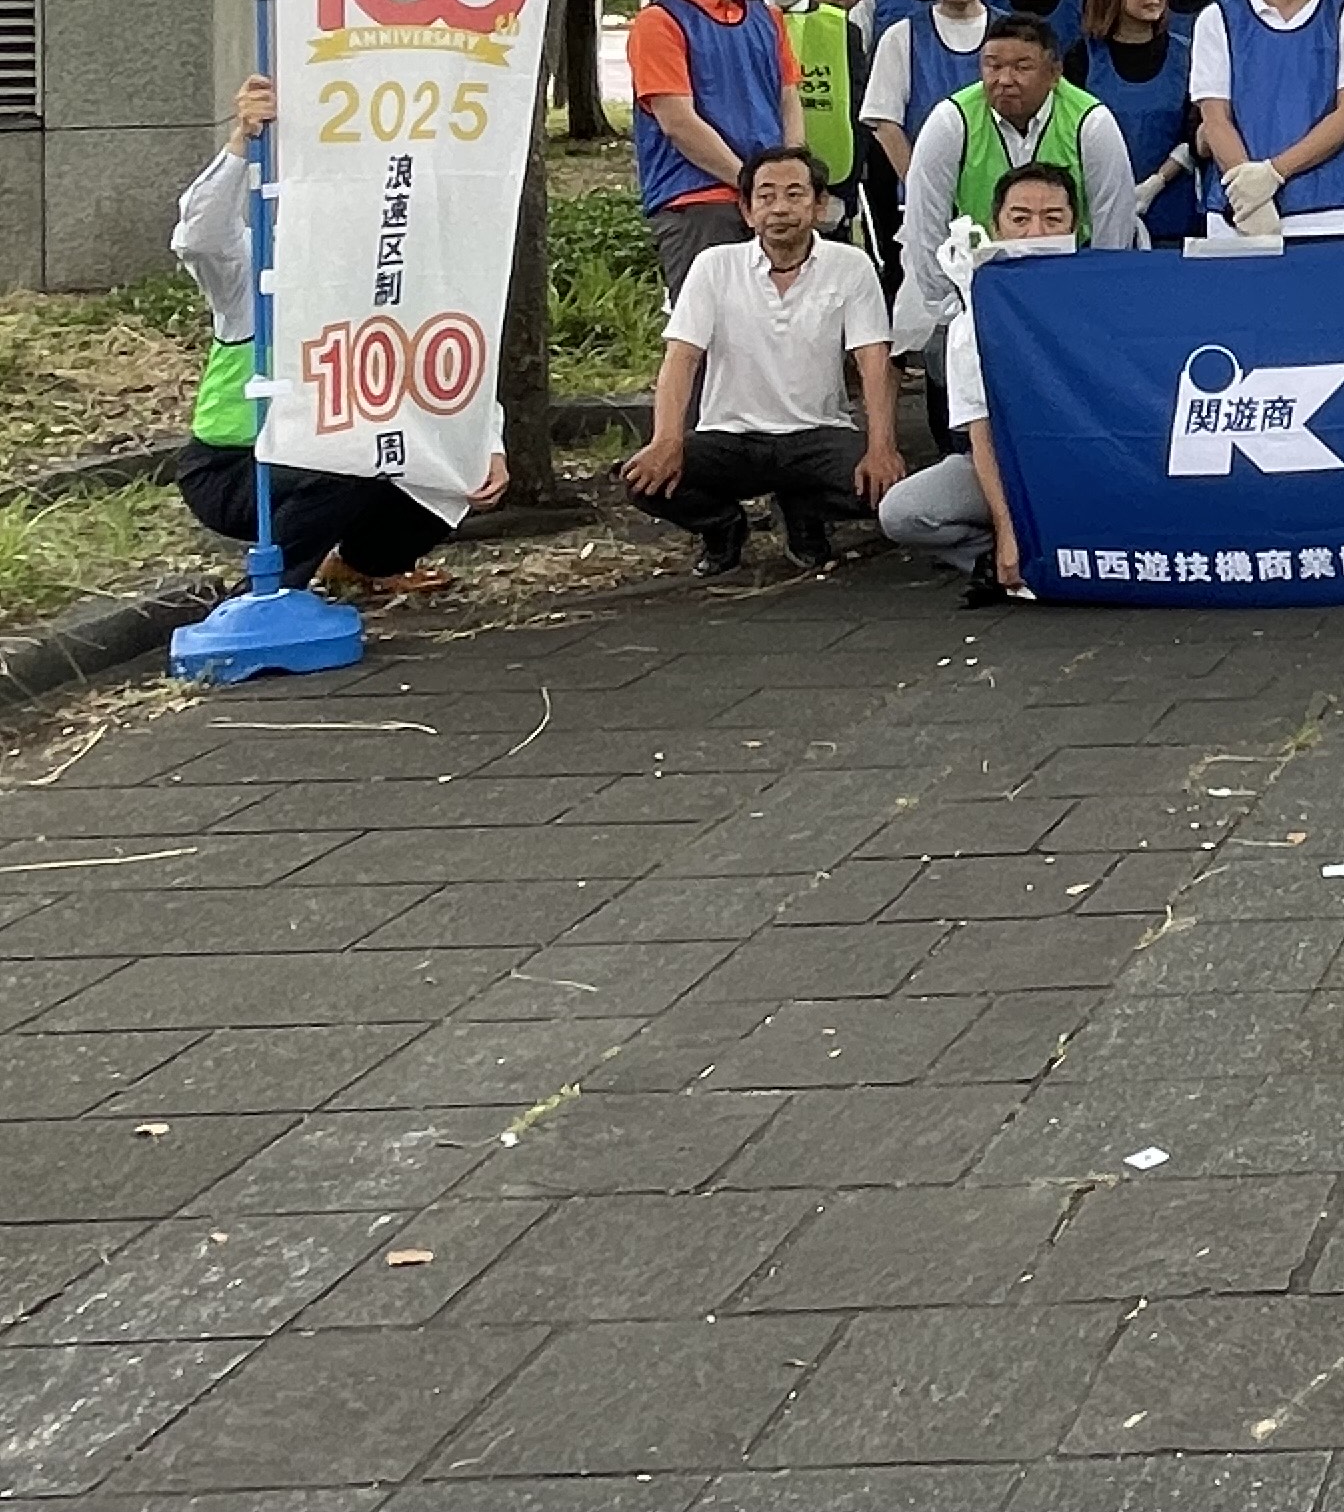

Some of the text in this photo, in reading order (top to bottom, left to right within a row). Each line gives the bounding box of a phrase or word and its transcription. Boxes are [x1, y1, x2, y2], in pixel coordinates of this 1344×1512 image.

[349, 28, 480, 51] ANNIVERSARY
[317, 80, 489, 143] 2025
[303, 312, 486, 435] 100
[1185, 395, 1297, 435] 関遊商
[375, 431, 405, 478] 周
